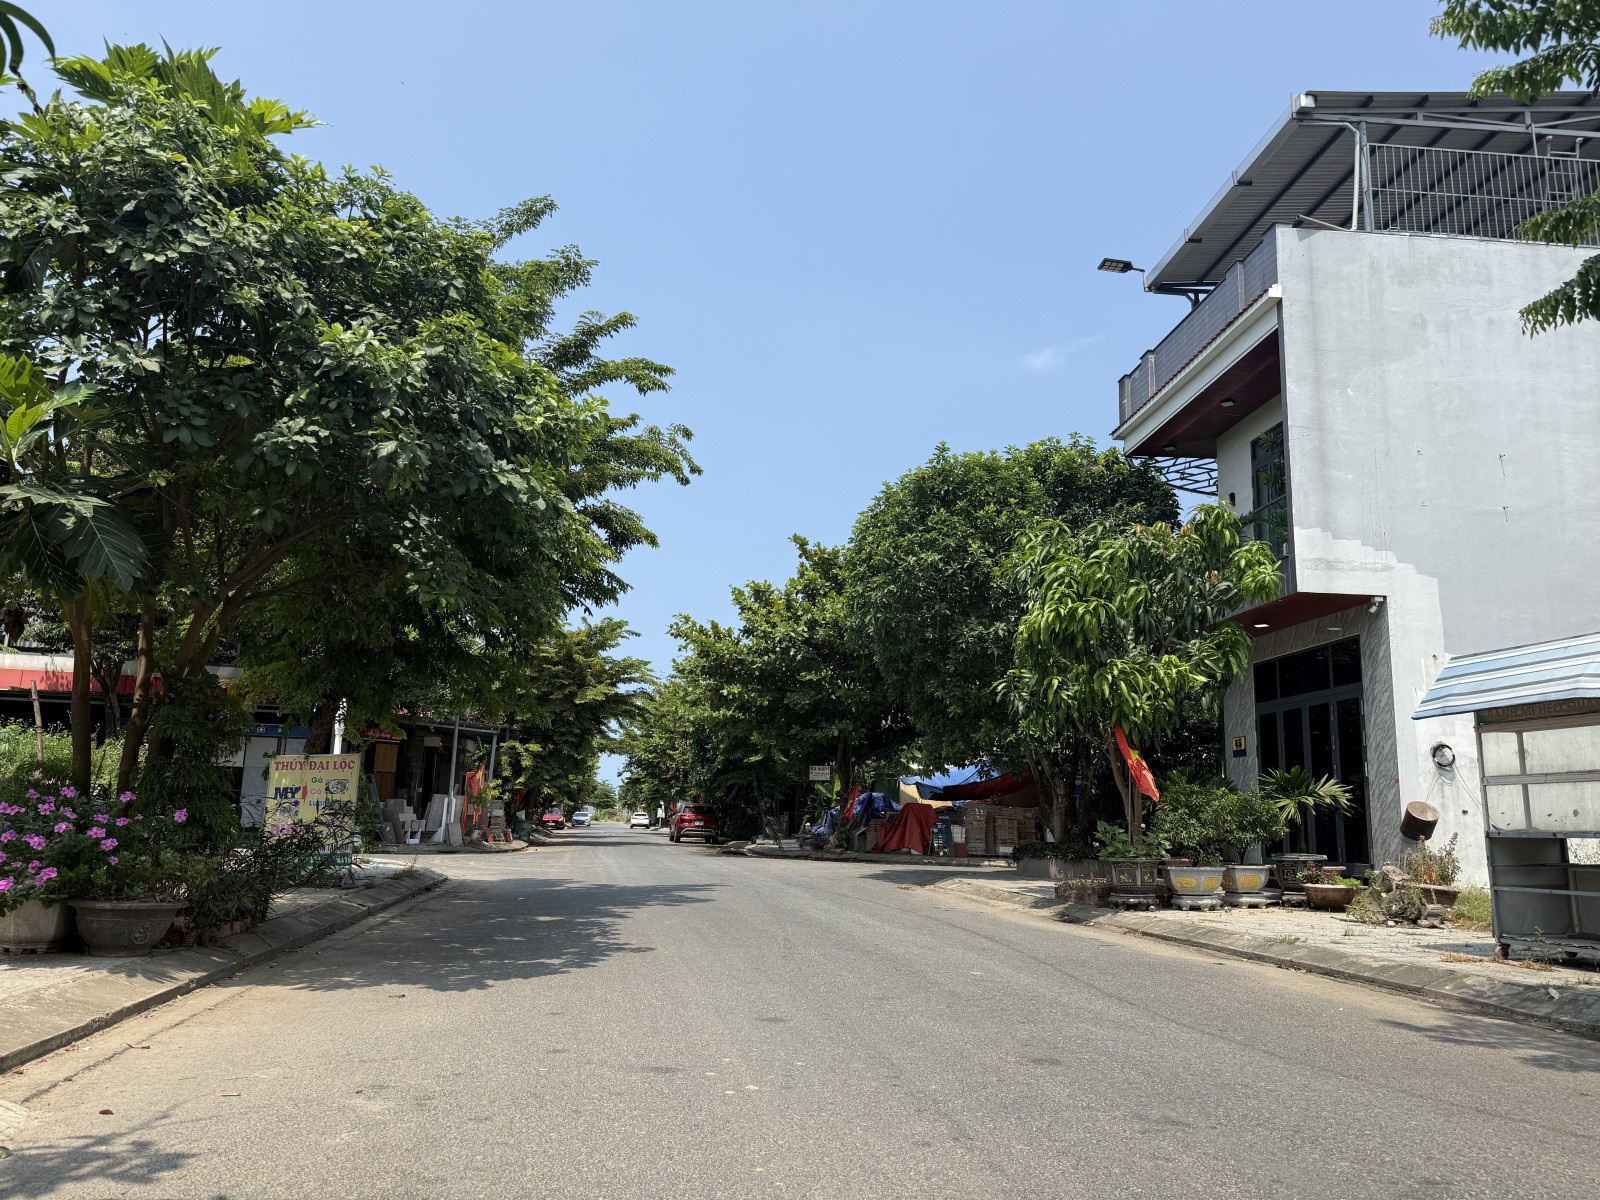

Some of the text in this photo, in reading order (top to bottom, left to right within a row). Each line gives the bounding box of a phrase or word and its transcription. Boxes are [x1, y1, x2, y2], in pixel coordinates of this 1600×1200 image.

[1539, 702, 1562, 715] HEO
[274, 758, 355, 773] THÚY ĐẠI LỘC
